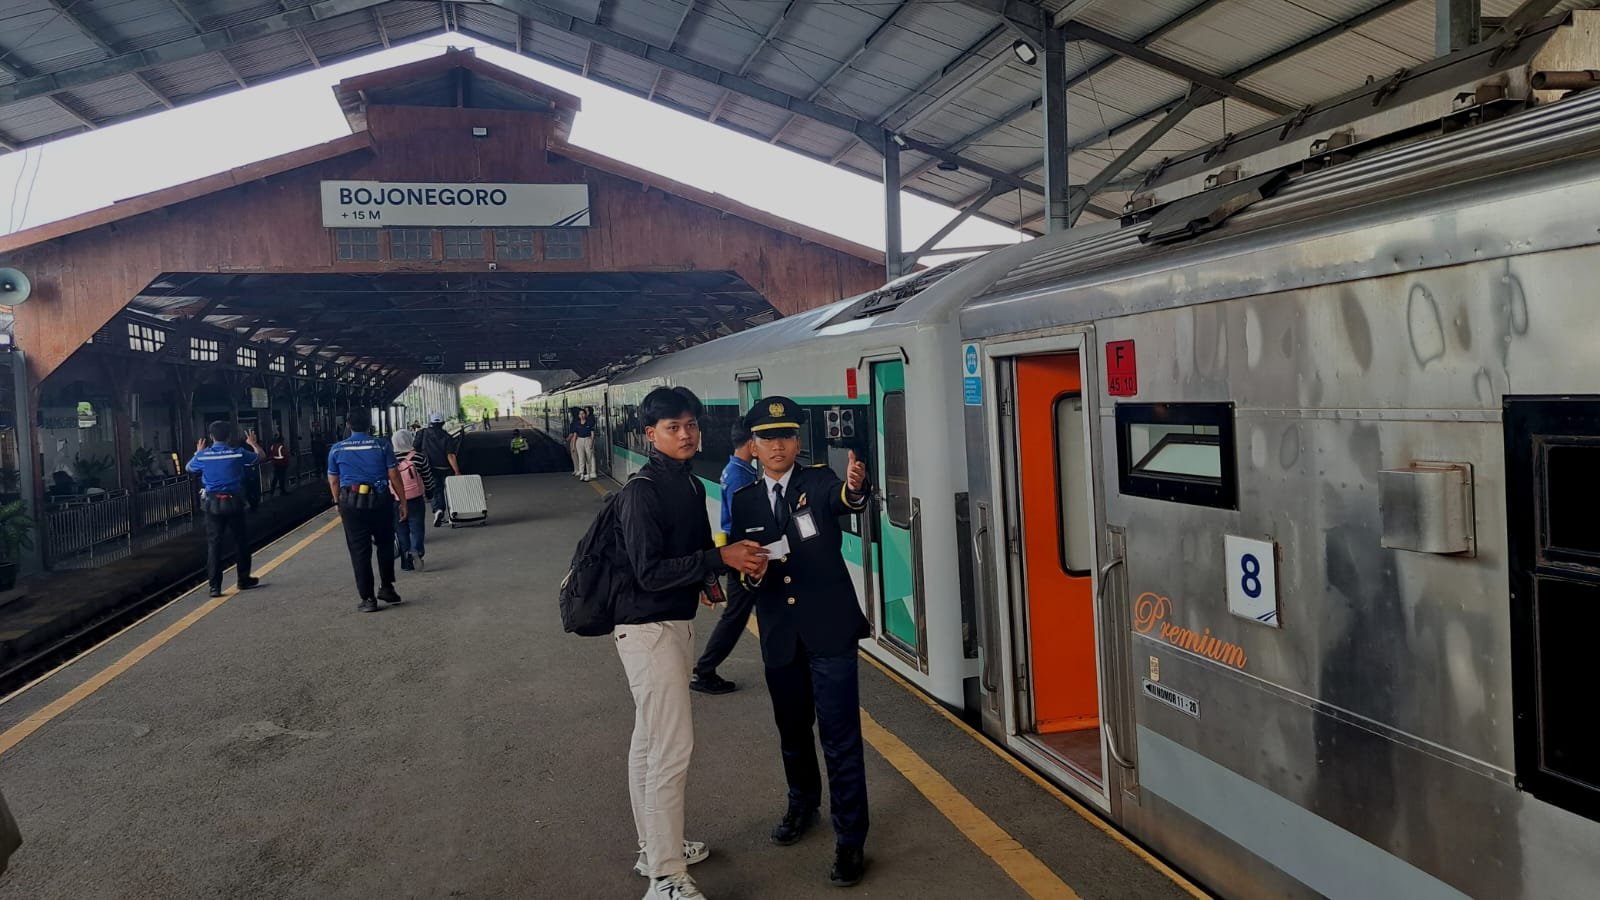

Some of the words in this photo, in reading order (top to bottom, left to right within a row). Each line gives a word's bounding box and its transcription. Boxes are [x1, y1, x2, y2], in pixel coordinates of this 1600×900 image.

[339, 187, 508, 206] BOJONEGORO
[352, 210, 366, 220] 15
[368, 210, 381, 220] M
[1115, 346, 1125, 369] F
[1109, 377, 1121, 392] 45
[1123, 377, 1134, 391] 10
[1240, 553, 1262, 599] 8
[1134, 591, 1248, 669] Premium
[1156, 686, 1177, 705] NOMOR
[1177, 696, 1184, 708] 11
[1189, 701, 1197, 713] 20
